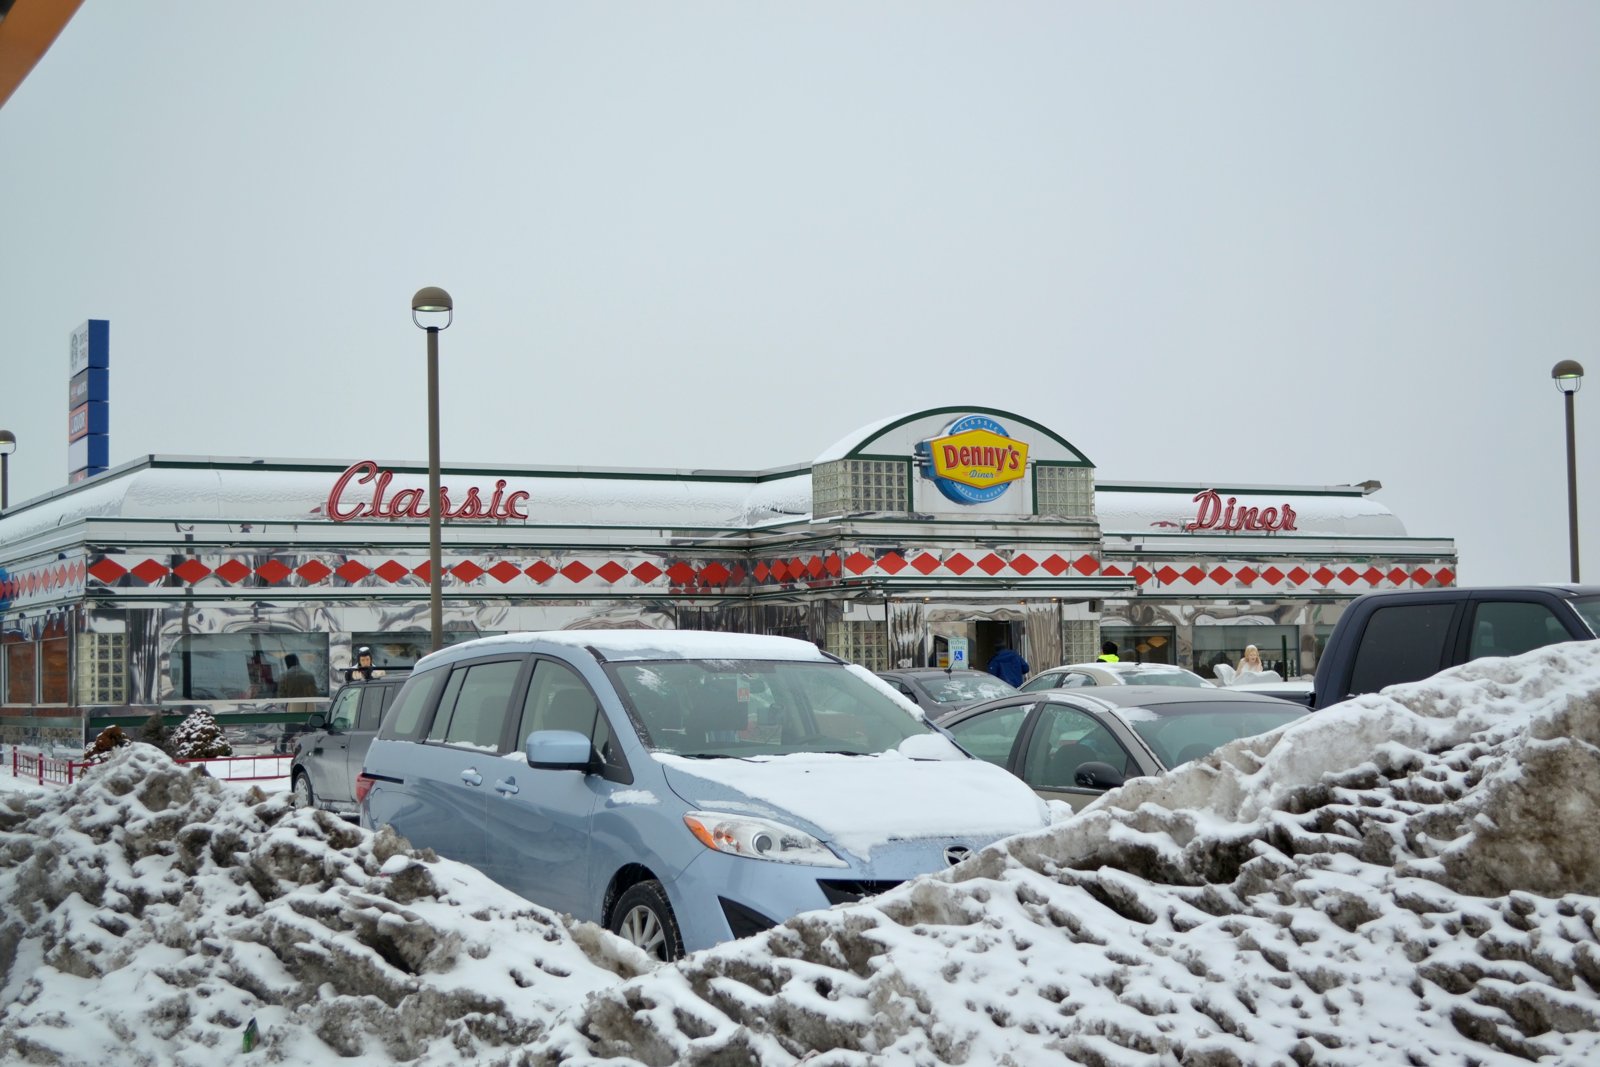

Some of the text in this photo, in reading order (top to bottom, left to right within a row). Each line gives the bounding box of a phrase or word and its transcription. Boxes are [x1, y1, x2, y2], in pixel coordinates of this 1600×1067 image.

[959, 419, 998, 432] CLASSIC
[943, 444, 1020, 472] Denny's
[326, 460, 530, 521] Classic
[1186, 489, 1298, 531] Diner
